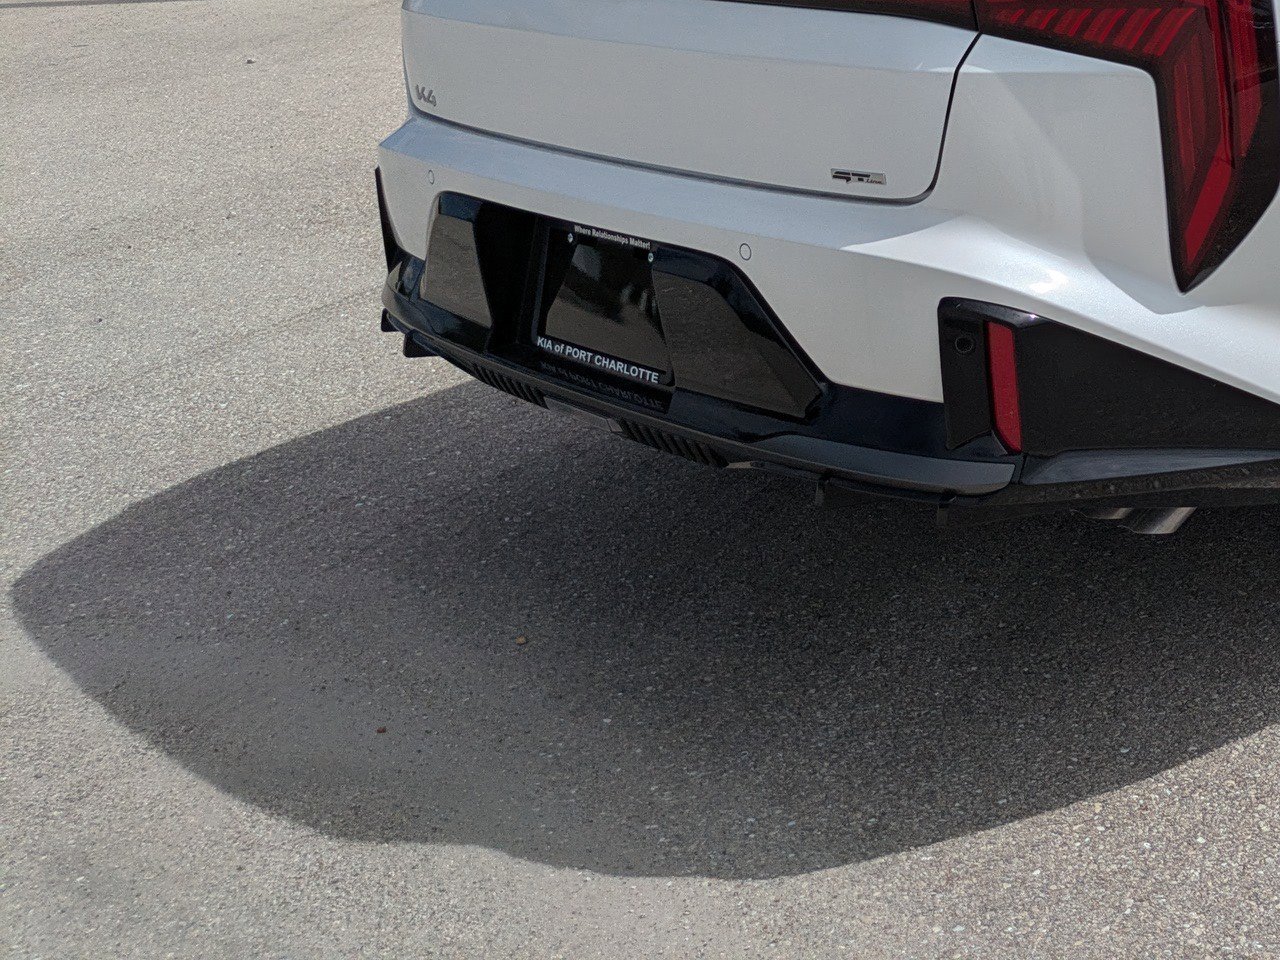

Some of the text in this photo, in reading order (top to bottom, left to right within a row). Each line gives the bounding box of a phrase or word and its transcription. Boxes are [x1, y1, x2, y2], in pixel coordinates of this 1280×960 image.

[416, 84, 437, 107] K4
[574, 225, 651, 250] Where Relationships Matter!
[536, 336, 660, 384] KIA of PORT CHARLOTTE
